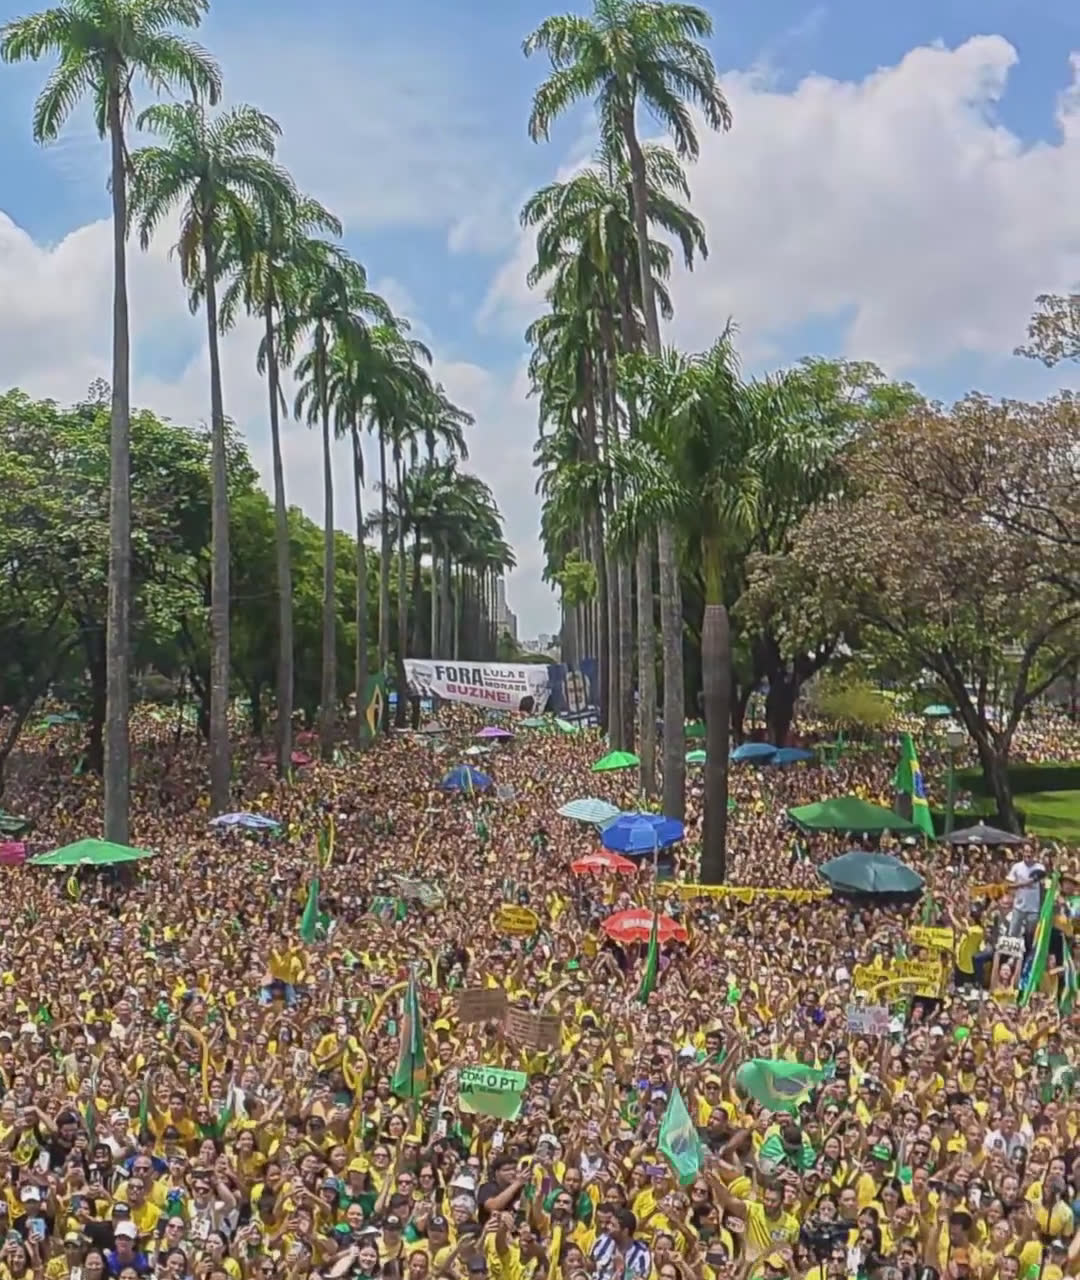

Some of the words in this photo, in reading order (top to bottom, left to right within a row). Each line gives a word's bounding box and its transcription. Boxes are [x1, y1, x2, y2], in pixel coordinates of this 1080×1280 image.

[434, 665, 484, 687] FORA
[484, 669, 515, 679] LULA
[519, 670, 525, 678] E
[446, 683, 511, 703] BUZINE!
[487, 1075, 497, 1087] O
[500, 1077, 518, 1091] PT
